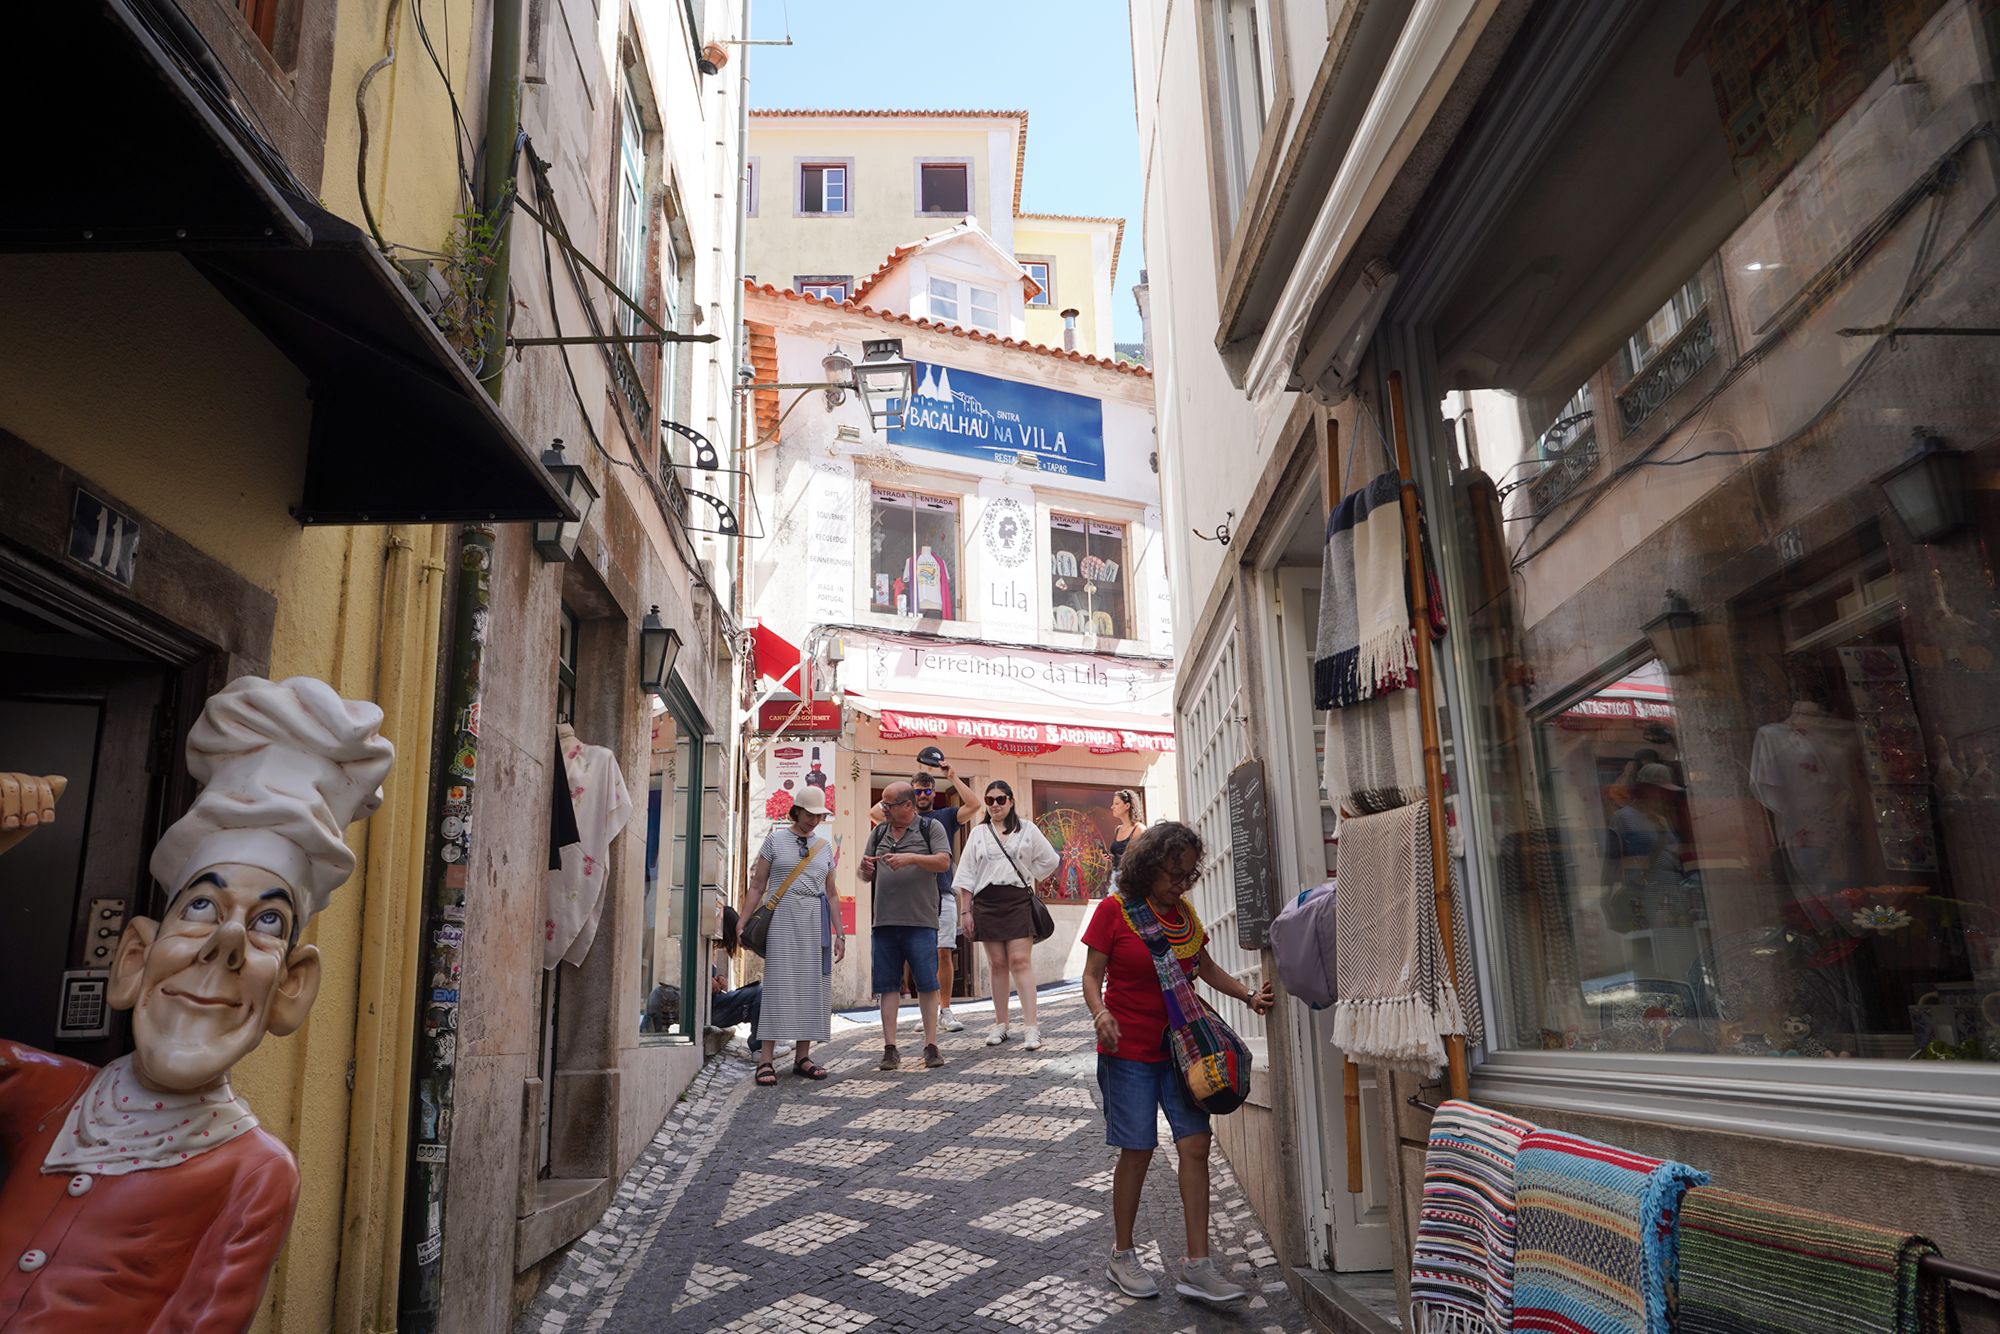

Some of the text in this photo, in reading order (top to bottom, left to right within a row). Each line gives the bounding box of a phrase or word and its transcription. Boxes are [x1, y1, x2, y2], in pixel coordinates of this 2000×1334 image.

[996, 410, 1020, 423] SINTRA
[910, 406, 1067, 454] BACALHAU NA VILA
[1047, 462, 1068, 474] TAPAS
[872, 488, 906, 499] ENTRADA
[920, 496, 953, 506] ENTRADA
[1050, 515, 1080, 525] ENTRADA
[1093, 523, 1122, 533] ENTRADA
[88, 505, 123, 576] 11
[815, 533, 848, 544] RECUERDOS
[809, 555, 853, 568] ERINNERUNGEN
[818, 593, 844, 603] PORTUGAL
[991, 580, 1028, 612] Lila
[908, 647, 1035, 680] Terreirinho
[1042, 661, 1066, 685] da
[1074, 663, 1108, 688] Lila
[898, 716, 948, 733] MUNDO
[1046, 725, 1115, 745] SARDINHA
[1121, 730, 1175, 750] PORTUG
[997, 742, 1040, 753] SARDINE
